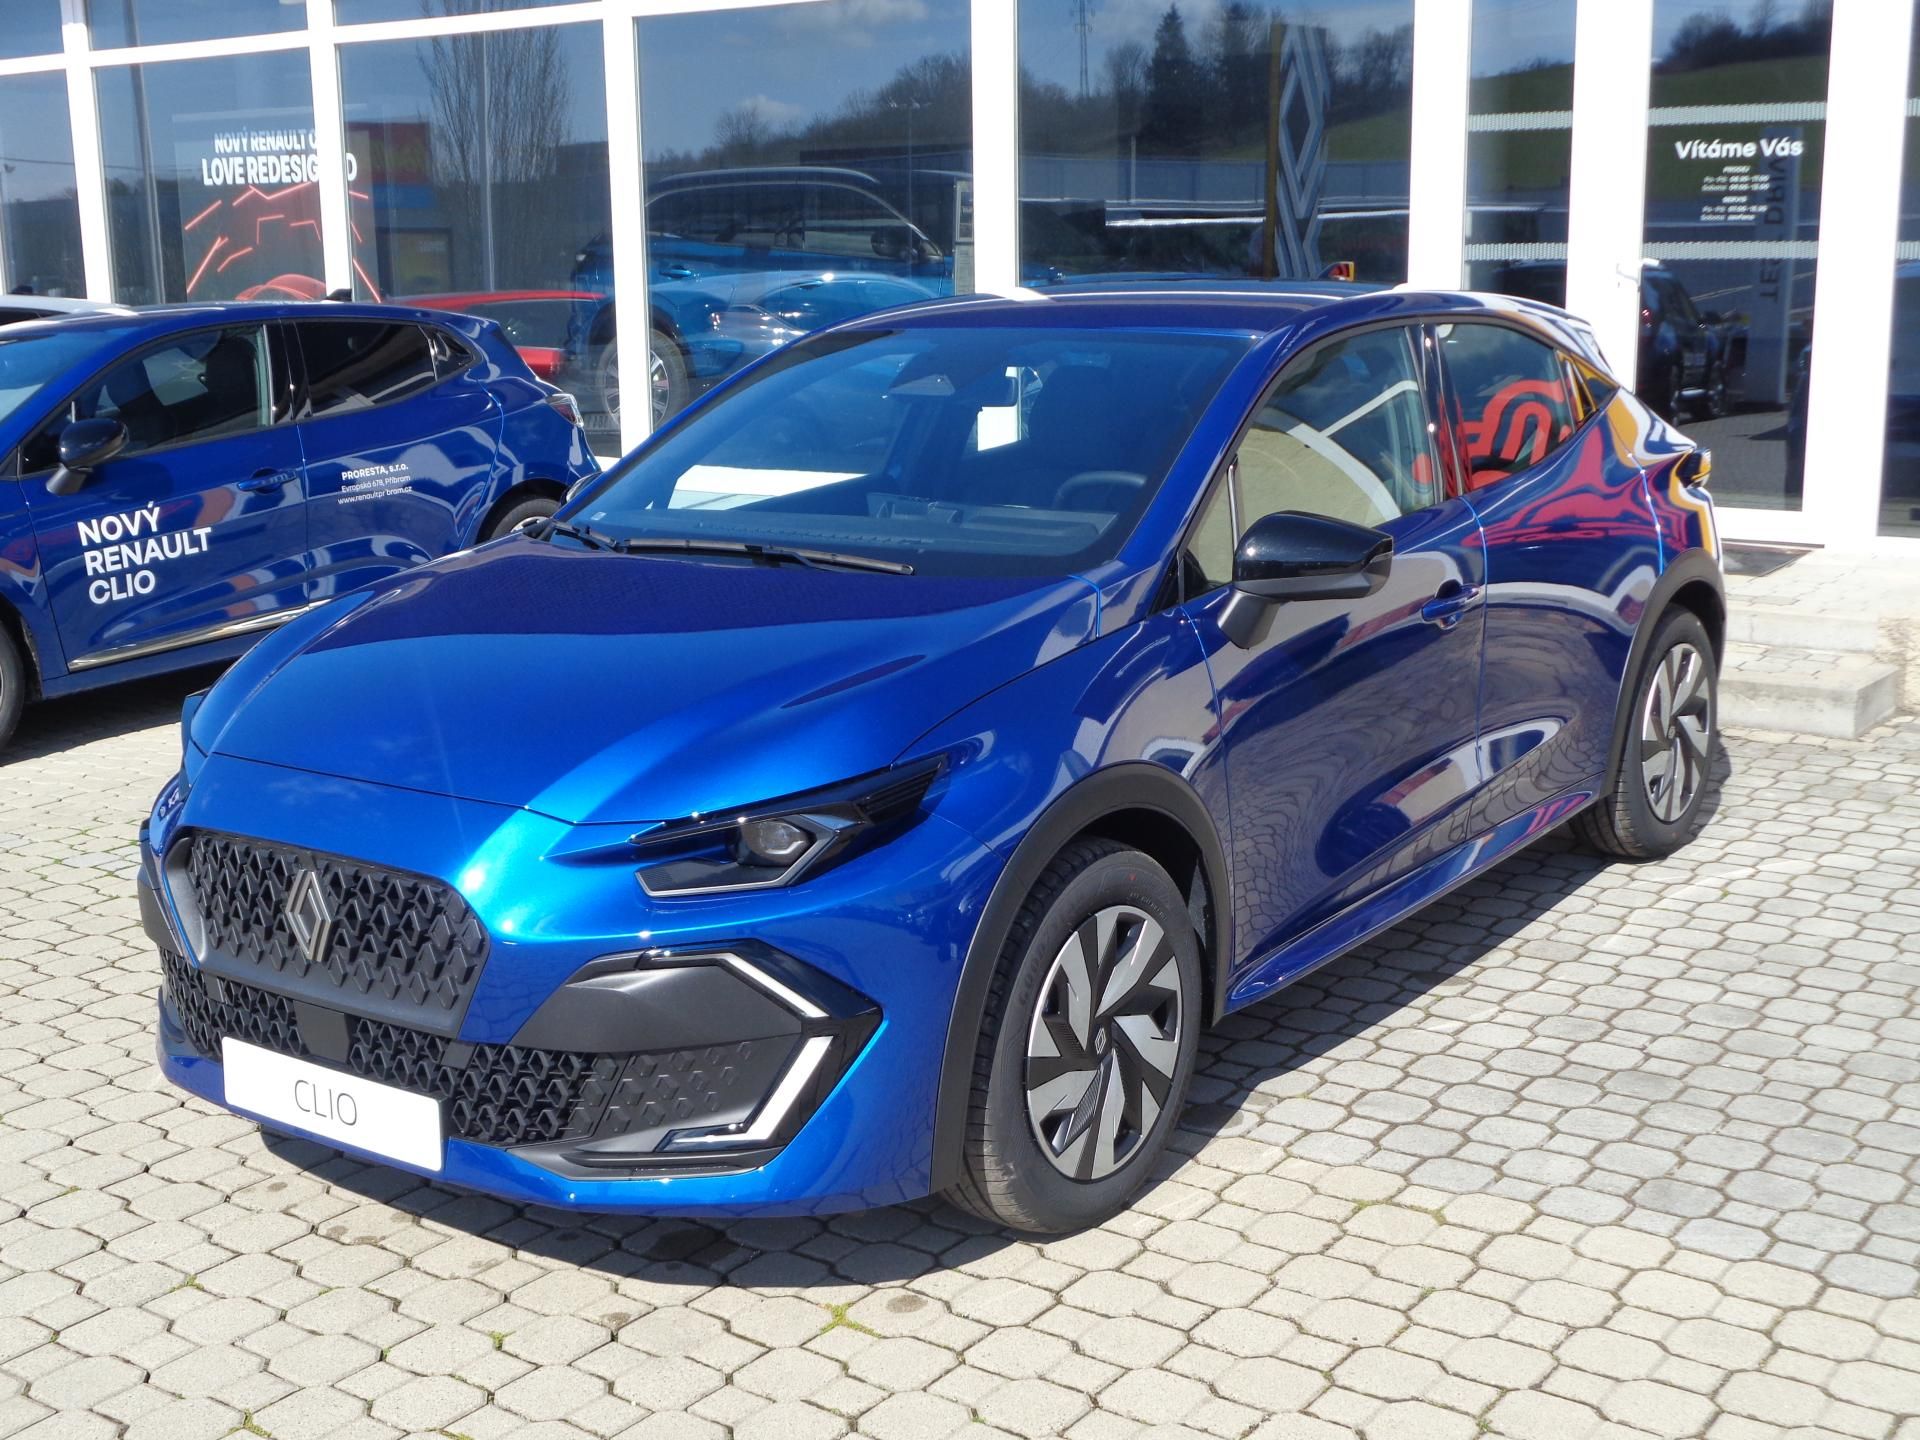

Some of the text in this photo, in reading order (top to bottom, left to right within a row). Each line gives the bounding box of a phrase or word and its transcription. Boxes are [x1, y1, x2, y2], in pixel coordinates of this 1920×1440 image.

[214, 126, 248, 153] NOVÝ
[251, 129, 307, 151] RENAULT
[1675, 137, 1803, 159] Vítáme Vás
[202, 153, 358, 185] LOVE REDESIGD
[341, 463, 409, 481] PRORESTA, s.r.o.
[338, 486, 412, 504] www.renaultprbram.cz
[77, 501, 160, 546] NOVÝ
[84, 527, 212, 576] RENAULT
[88, 569, 156, 605] CLIO
[295, 1079, 358, 1126] CLIO
